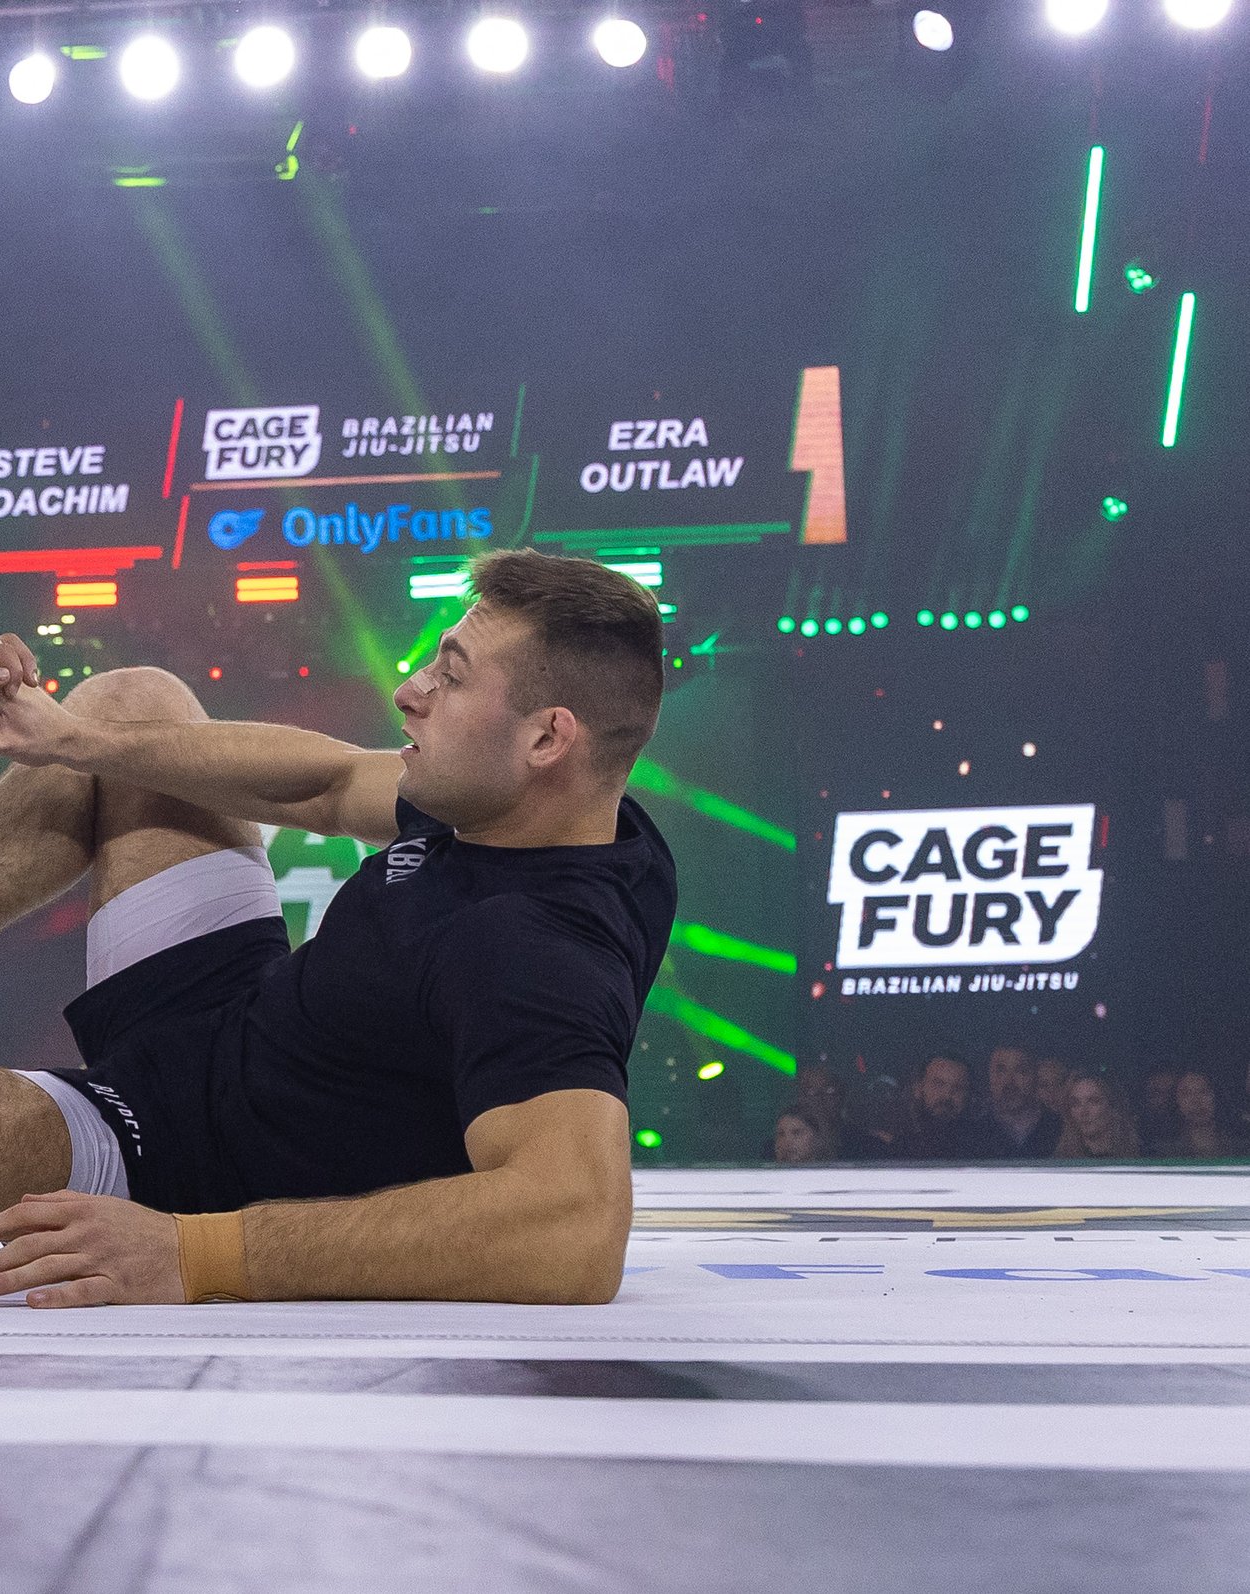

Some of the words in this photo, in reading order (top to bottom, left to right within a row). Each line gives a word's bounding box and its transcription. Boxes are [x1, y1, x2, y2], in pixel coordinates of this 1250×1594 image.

[214, 415, 310, 441] CAGE
[341, 412, 495, 438] BRAZILIAN
[607, 417, 709, 452] EZRA
[216, 444, 310, 470] FURY
[341, 432, 481, 458] JIU-JITSU
[580, 456, 744, 493] OUTLAW
[282, 502, 494, 554] OnlyFans
[848, 823, 1074, 885] CAGE
[857, 889, 1082, 951] FURY
[841, 974, 962, 996] BRAZILIAN
[968, 971, 1080, 993] JIU-JITSU
